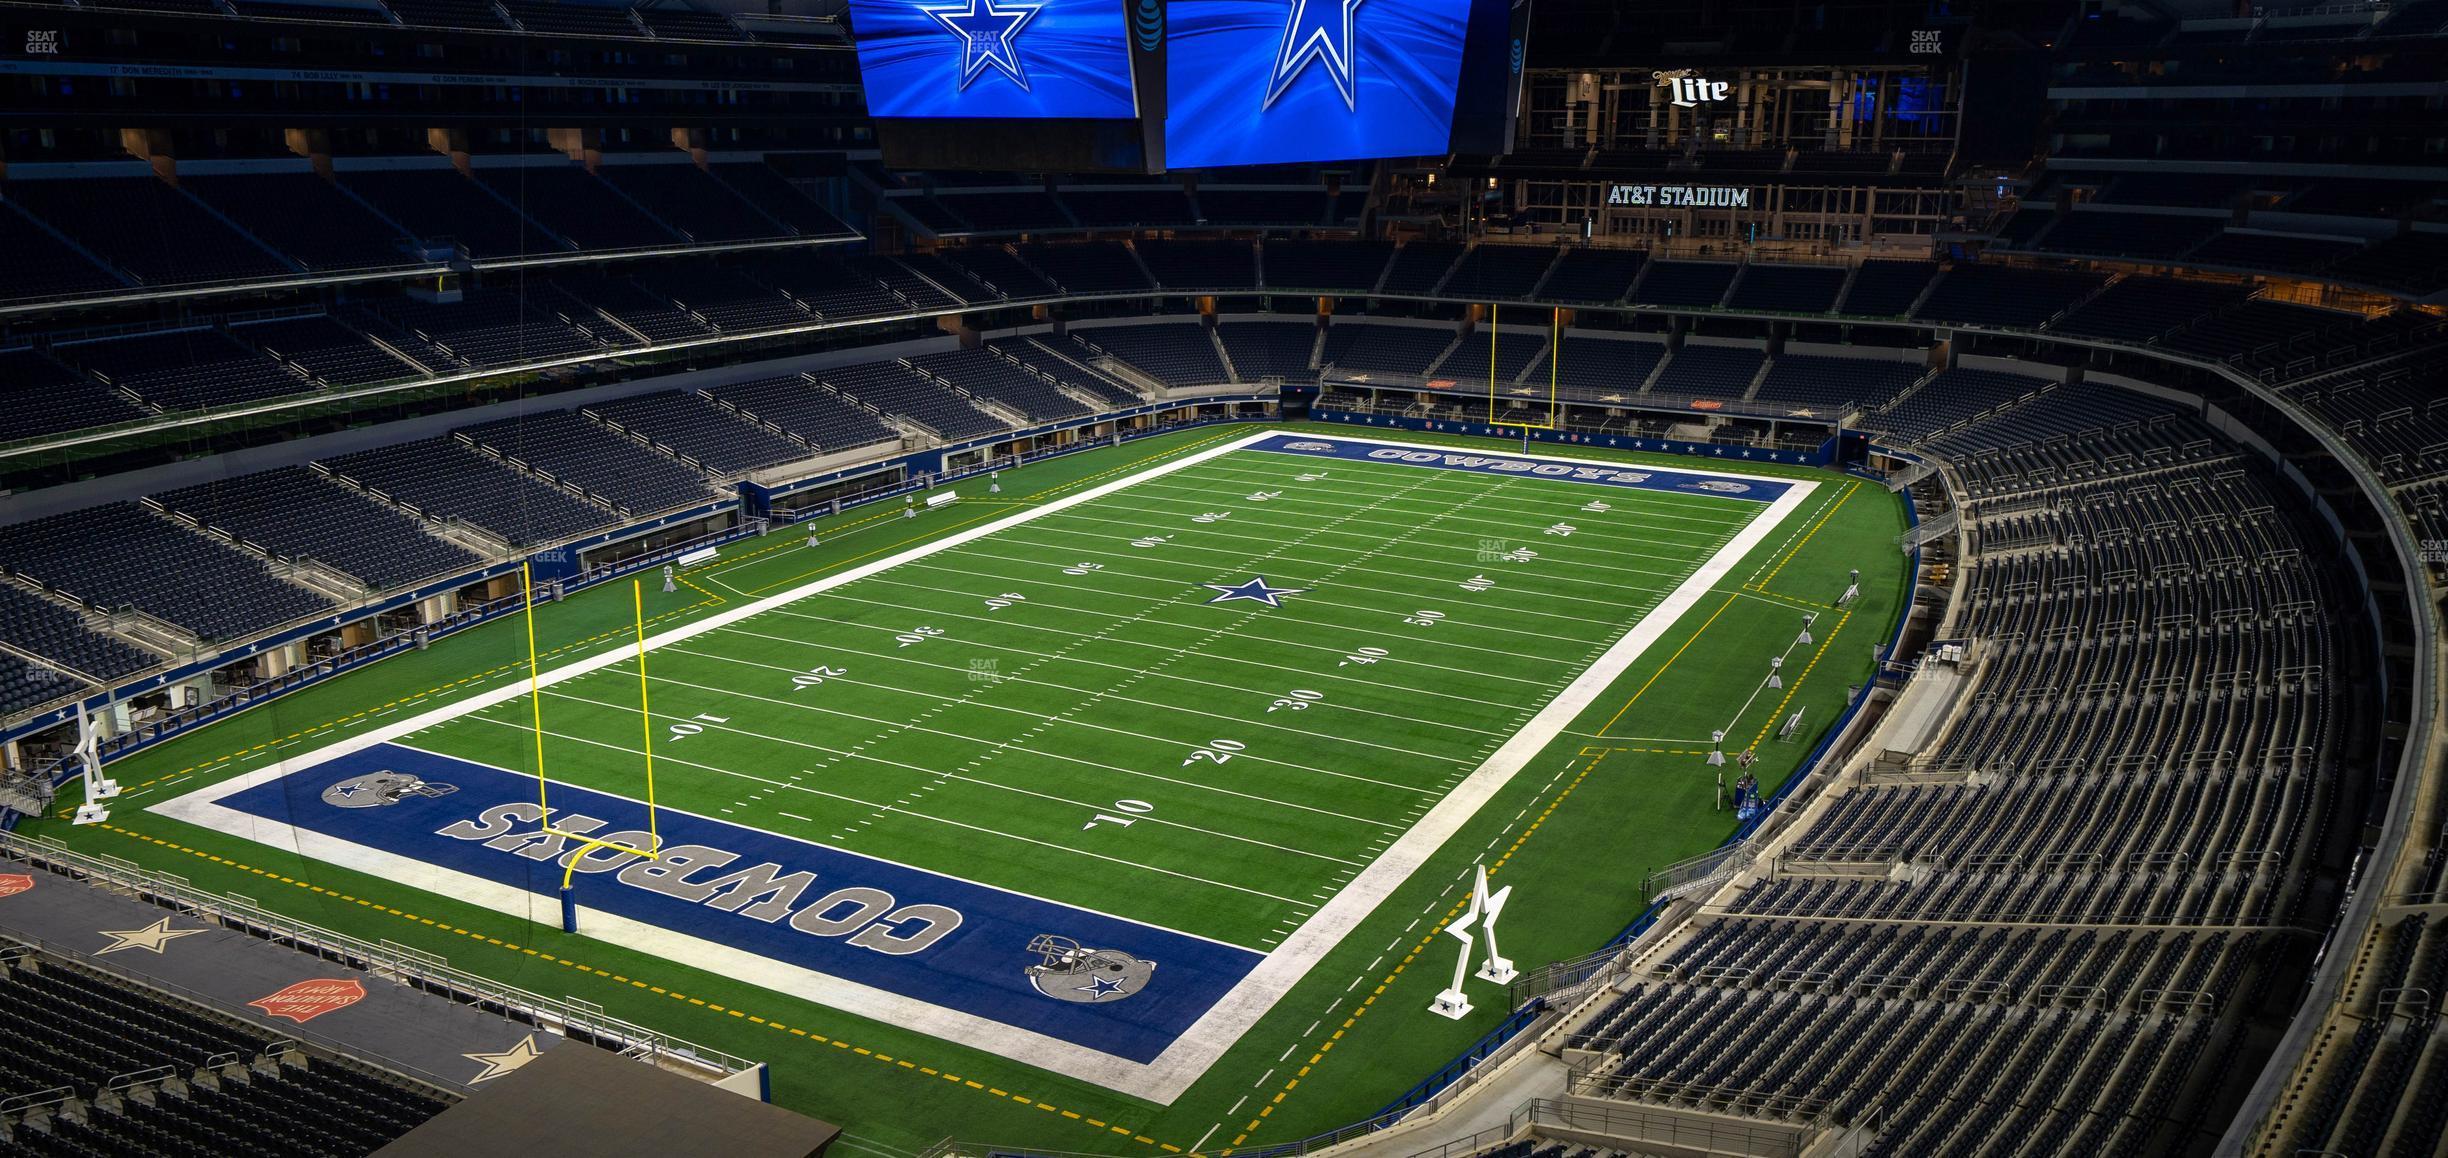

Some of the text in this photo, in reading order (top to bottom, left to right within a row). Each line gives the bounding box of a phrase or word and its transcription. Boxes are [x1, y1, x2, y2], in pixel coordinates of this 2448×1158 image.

[1668, 78, 1729, 107] Lite
[1607, 186, 1749, 207] AT&T STADIUM
[1368, 448, 1651, 483] COWBOYS
[1246, 491, 1278, 501] 20
[1581, 502, 1612, 513] 10
[1543, 525, 1577, 537] 20
[1131, 536, 1166, 548] 40
[1502, 550, 1538, 562] 30
[1063, 562, 1104, 575] 50
[1458, 578, 1496, 592] 40
[985, 592, 1026, 607] 40
[1403, 610, 1446, 627] 50
[895, 626, 944, 643] 30
[1346, 647, 1389, 665] 40
[791, 665, 847, 685] 20
[1273, 690, 1323, 710] 30
[669, 712, 731, 735] 10
[1190, 739, 1246, 765] 20
[1092, 799, 1154, 828] 10
[434, 802, 963, 955] COWBOYS
[287, 984, 353, 995] ARMY
[261, 994, 359, 1005] SALVATION
[278, 1004, 320, 1013] THE
